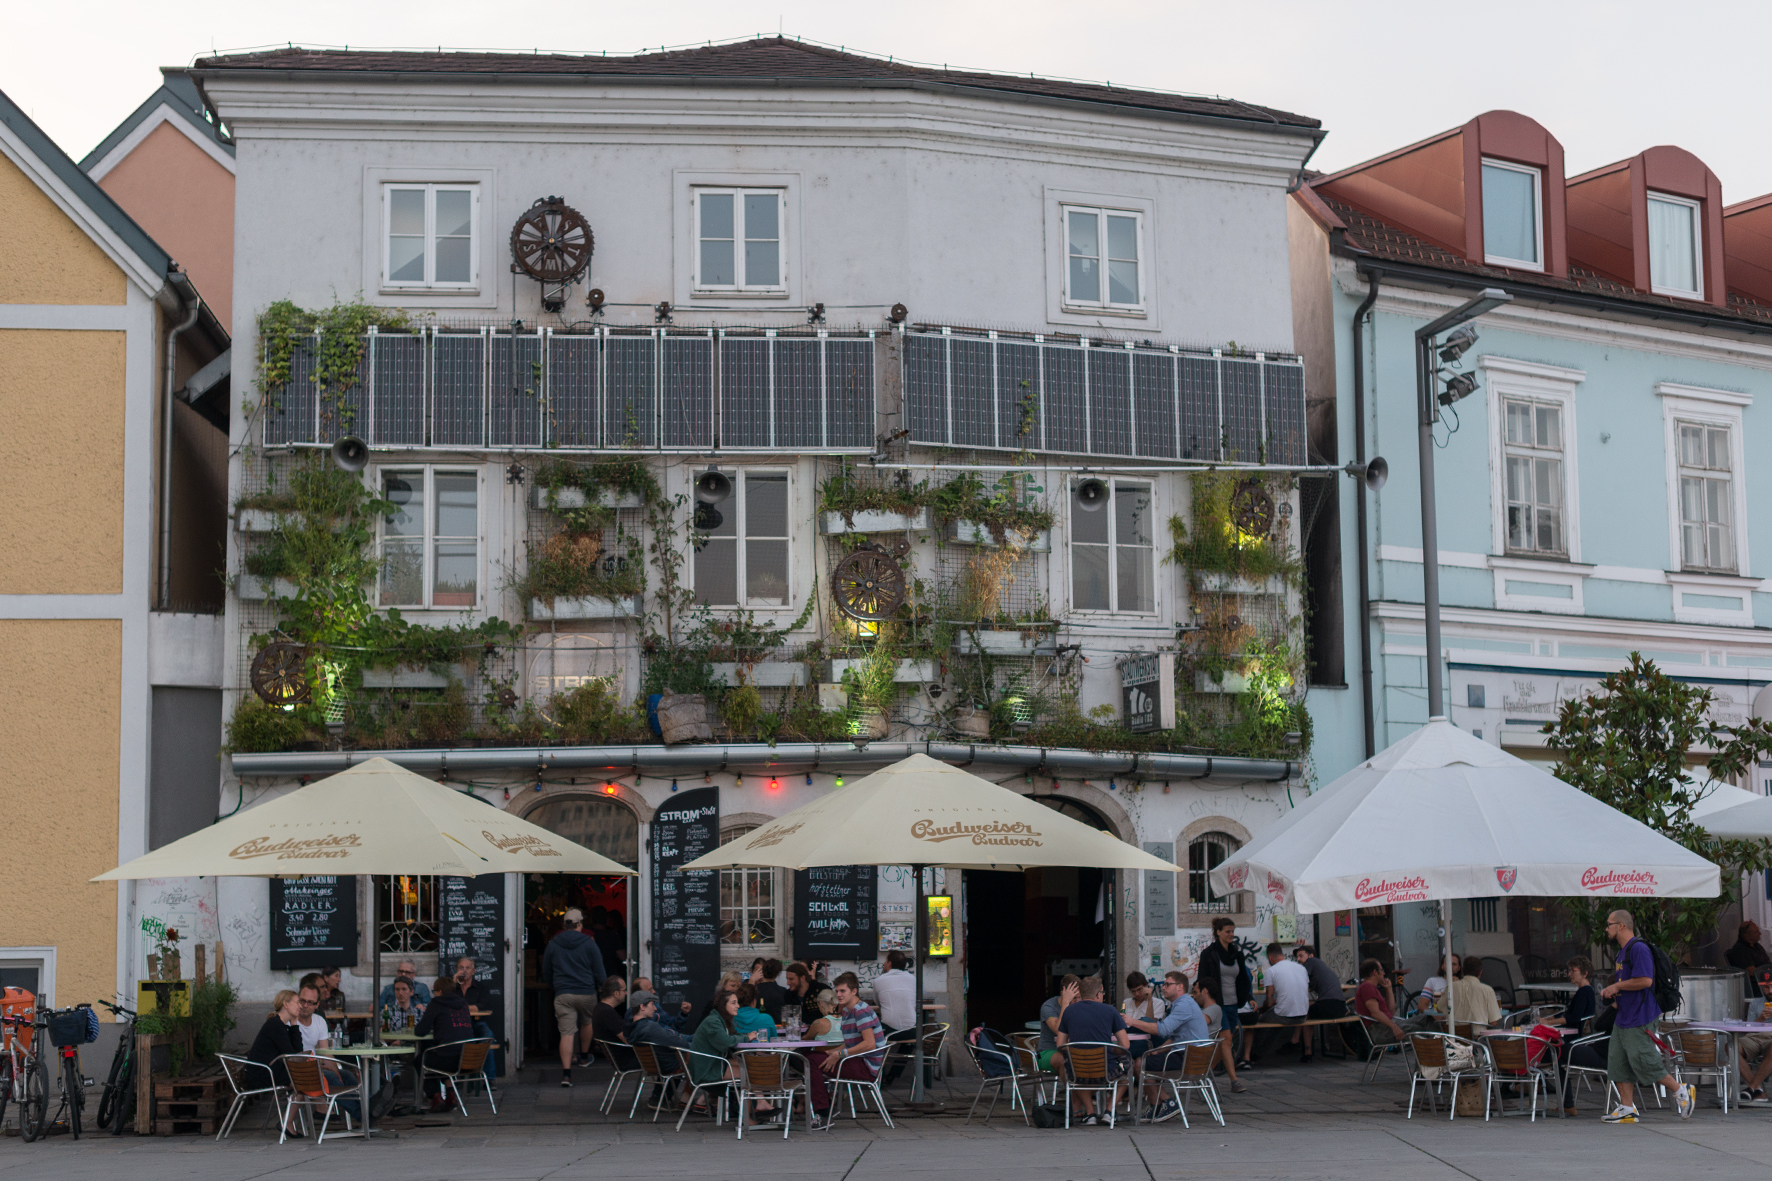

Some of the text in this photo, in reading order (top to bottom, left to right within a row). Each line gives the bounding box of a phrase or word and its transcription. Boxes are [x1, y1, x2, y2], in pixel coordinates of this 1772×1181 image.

[660, 809, 700, 821] STROM
[910, 819, 1042, 842] Budweiser
[228, 834, 362, 859] Budweiser
[972, 832, 1043, 847] Budvar
[277, 848, 352, 860] Budvar
[1581, 866, 1658, 890] Budweiser
[1355, 876, 1429, 902] Budweiser
[1613, 881, 1656, 895] Budvar
[1387, 890, 1428, 903] Budvar
[285, 901, 332, 910] RADLER
